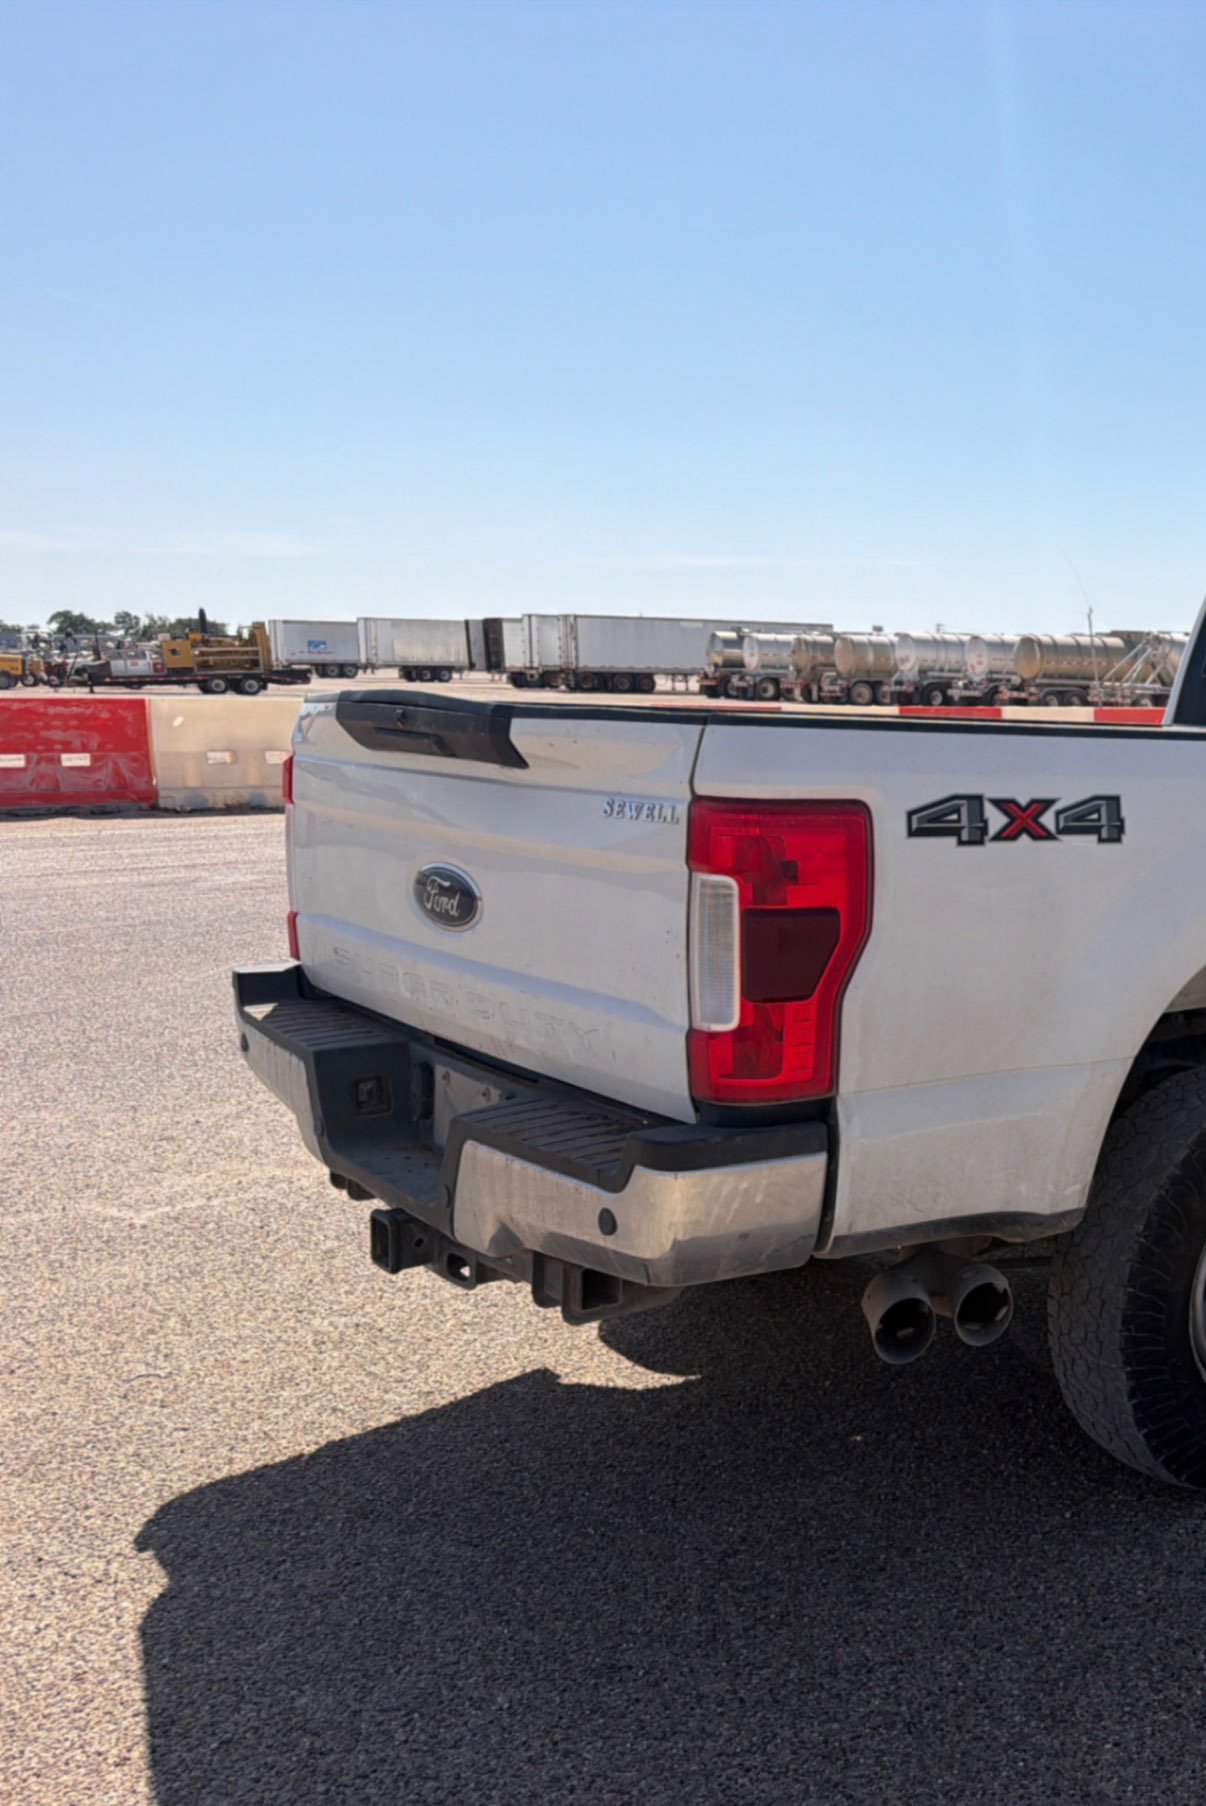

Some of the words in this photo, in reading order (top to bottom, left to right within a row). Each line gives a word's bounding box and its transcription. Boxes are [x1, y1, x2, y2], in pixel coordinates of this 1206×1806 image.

[602, 798, 680, 825] SEWELL
[906, 793, 1125, 847] 4X4
[424, 875, 460, 917] Ford
